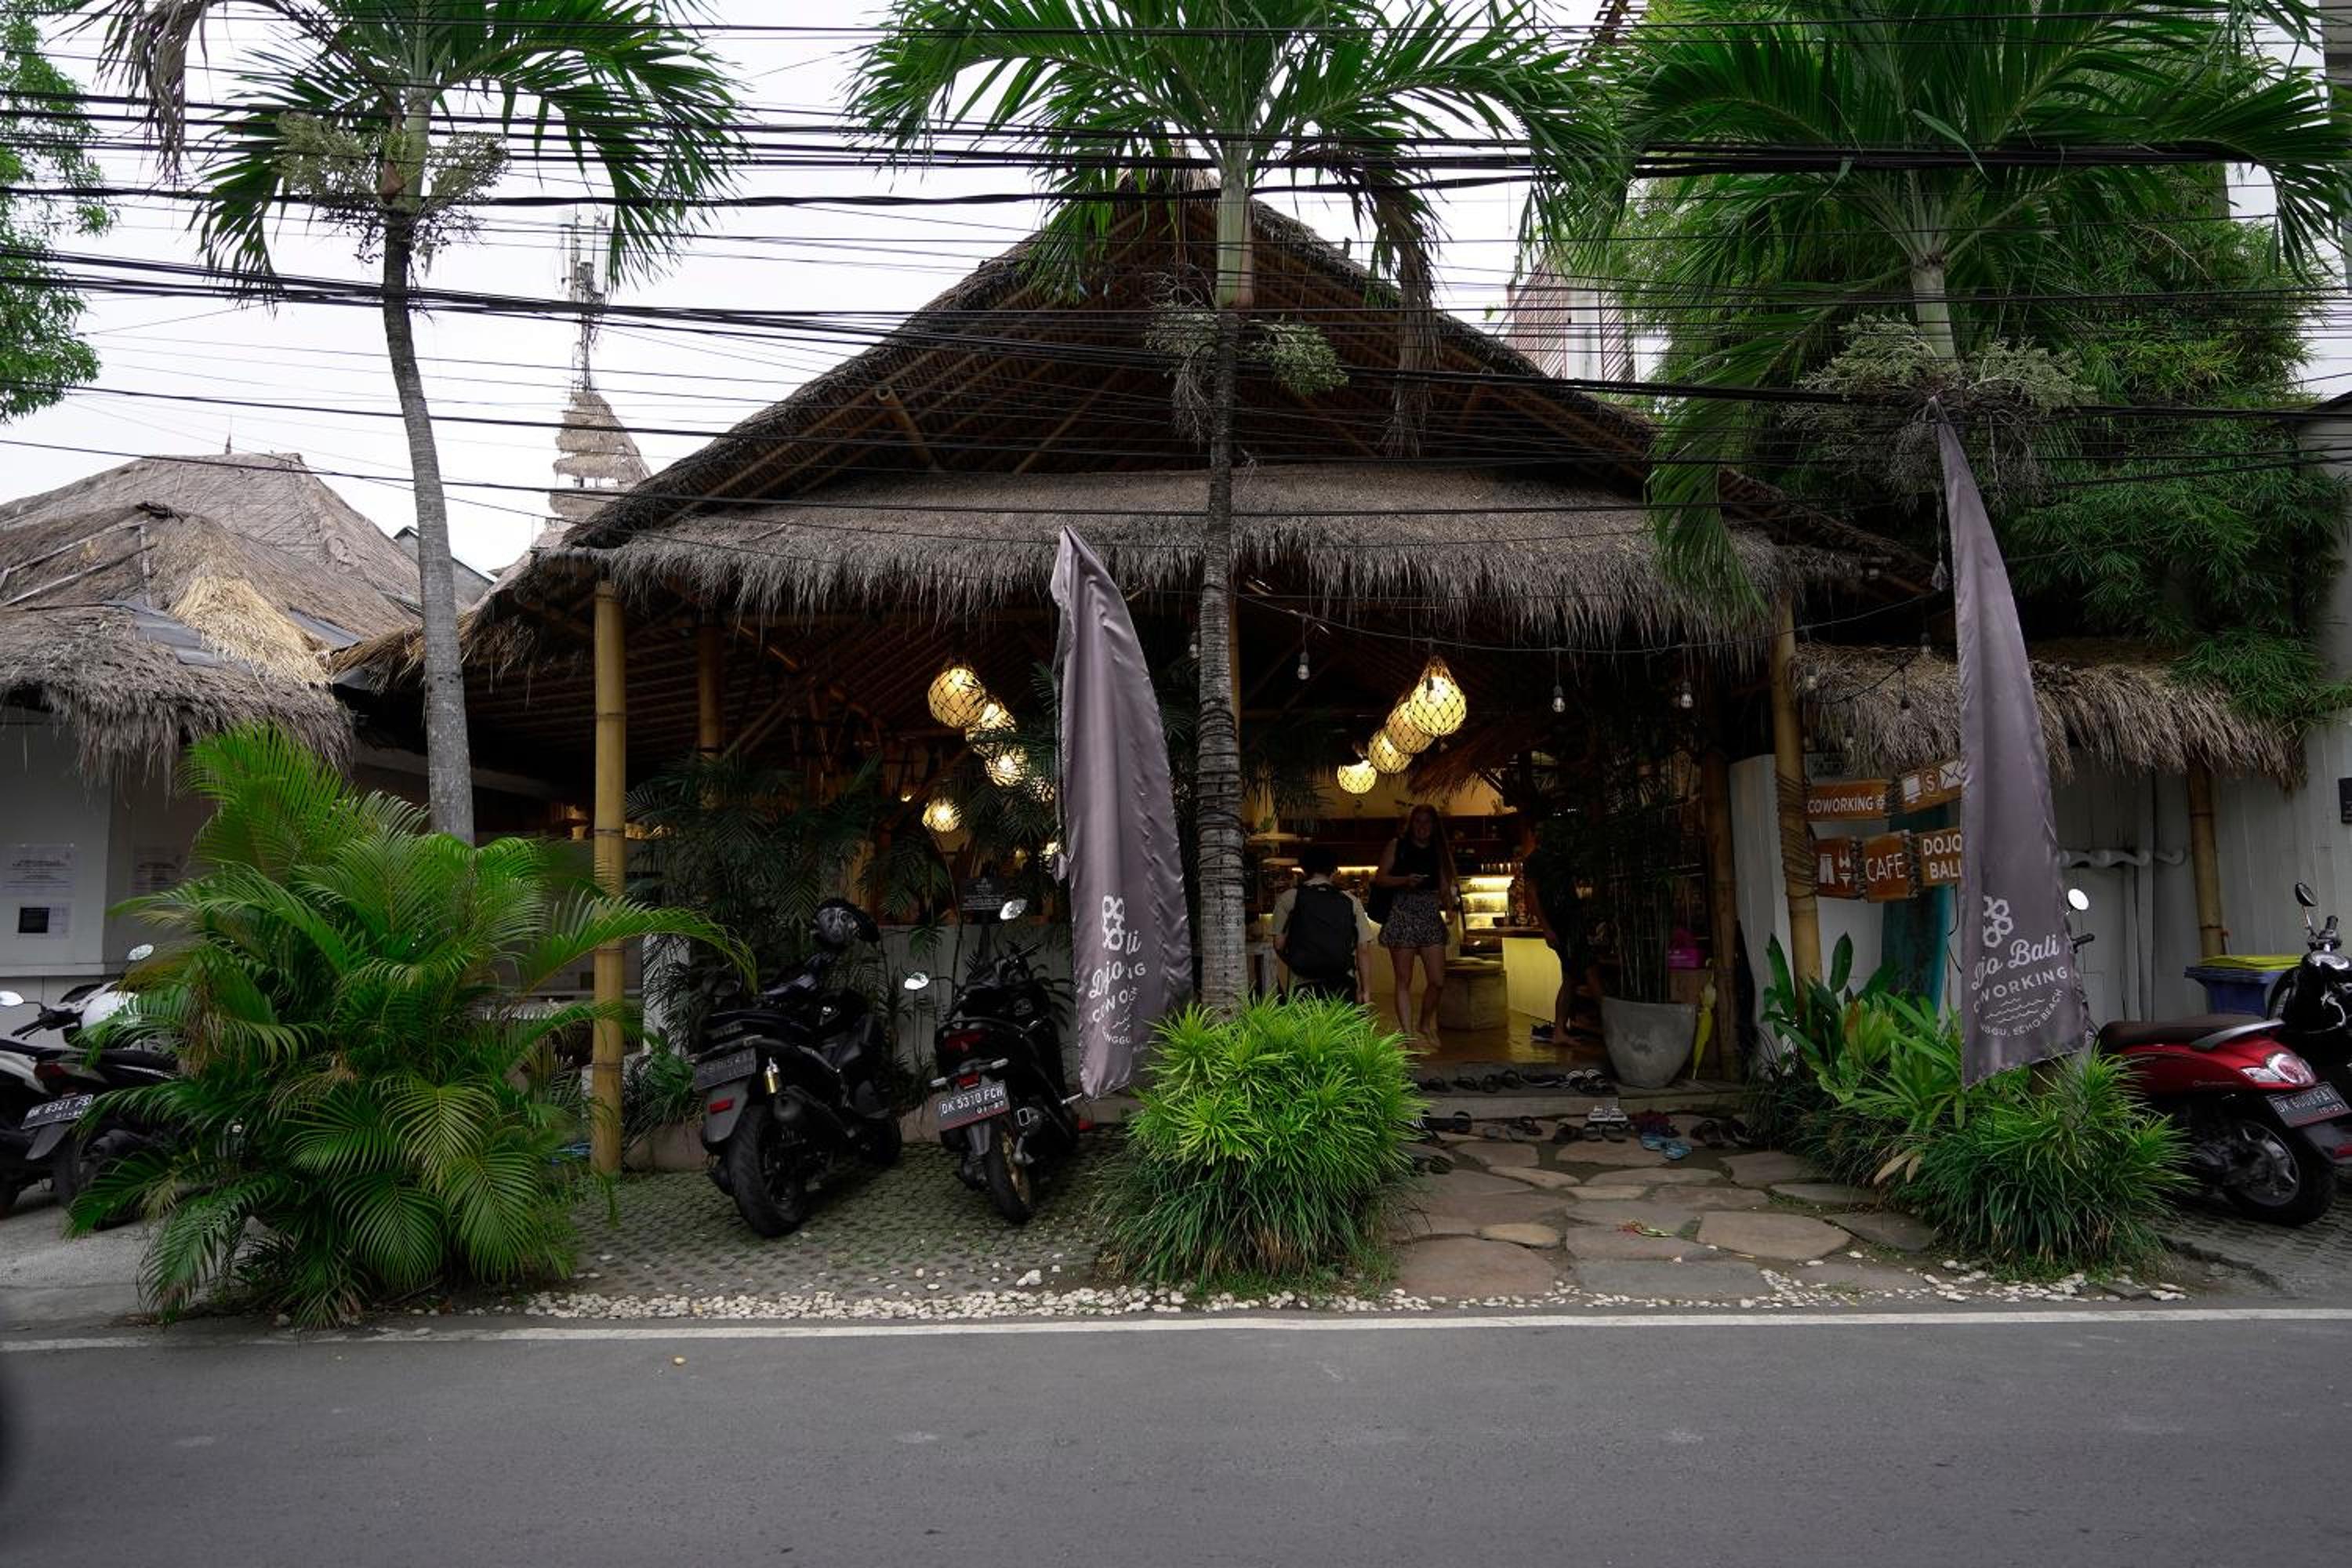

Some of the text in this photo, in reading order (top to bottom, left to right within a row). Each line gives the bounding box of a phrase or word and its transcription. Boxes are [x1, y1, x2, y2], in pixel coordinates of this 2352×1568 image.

[1807, 796, 1873, 814] COWORKING
[1923, 833, 1962, 855] DOJO
[1865, 852, 1907, 882] CAFE
[1929, 858, 1962, 880] BALI
[2007, 934, 2060, 969] Bali
[942, 1100, 955, 1114] DK
